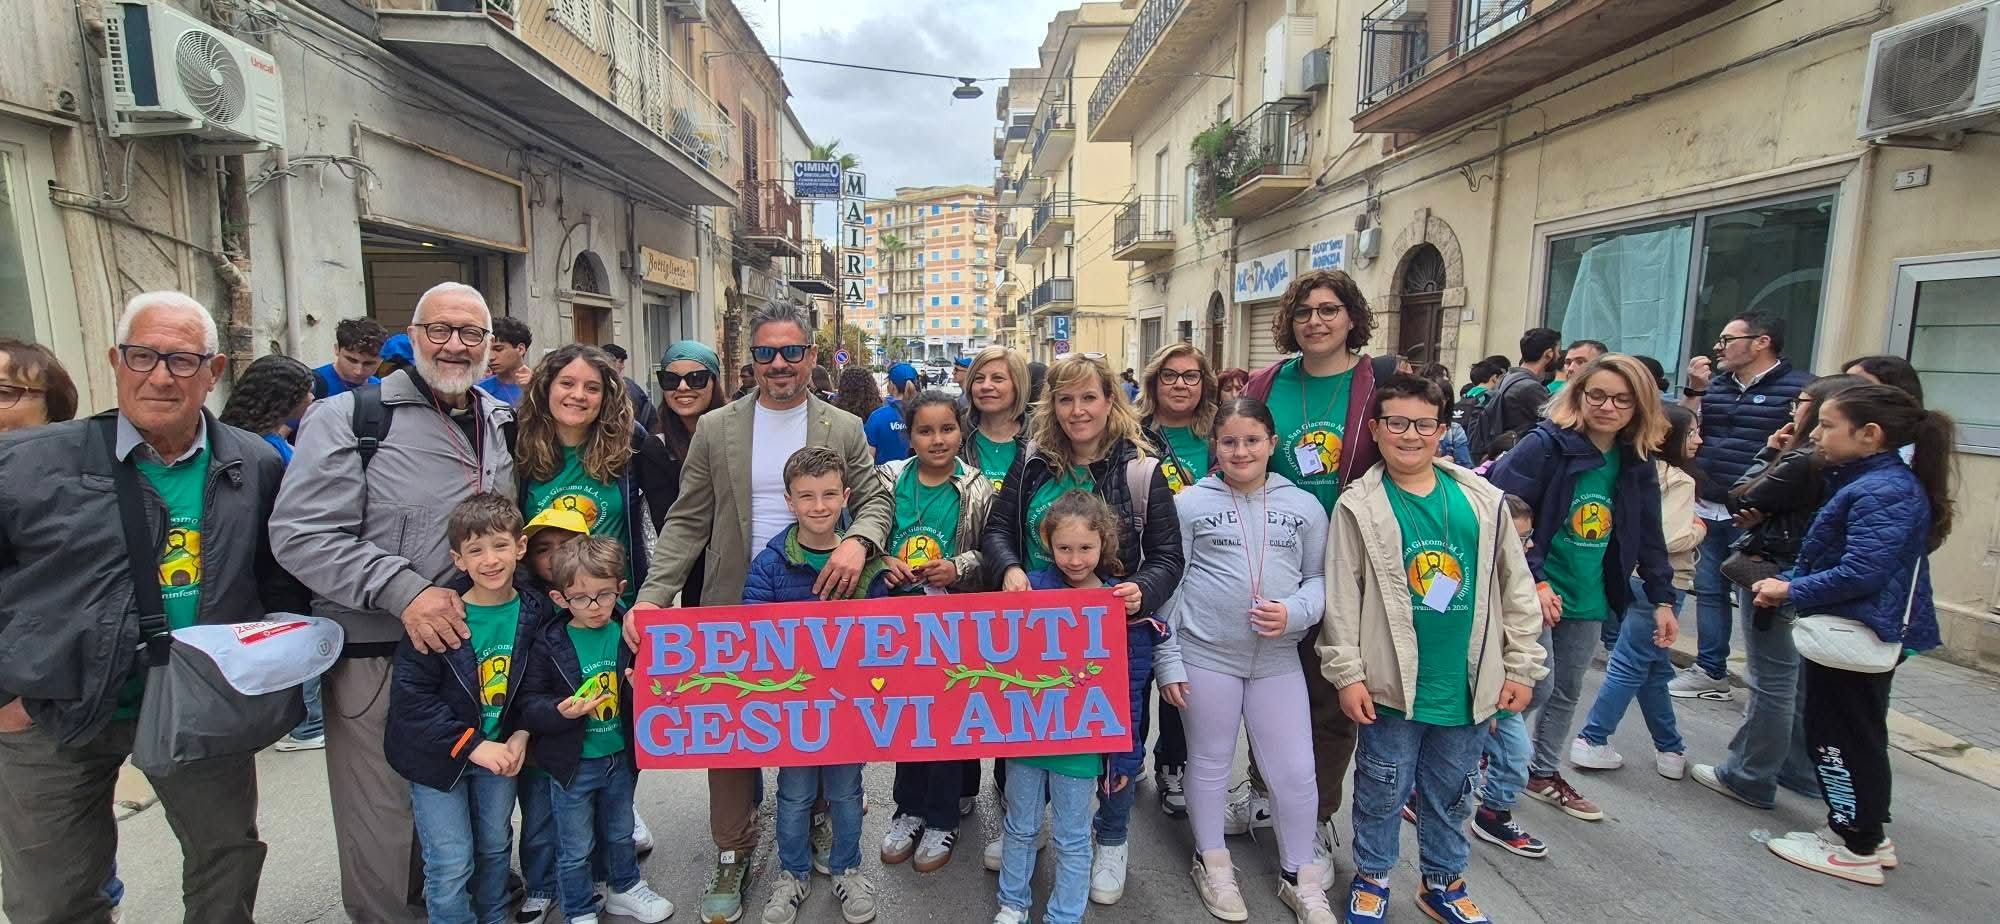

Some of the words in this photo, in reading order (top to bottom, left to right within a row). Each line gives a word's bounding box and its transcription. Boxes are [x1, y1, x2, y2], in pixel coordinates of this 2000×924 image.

[795, 162, 840, 178] CIMINO
[1907, 171, 1915, 184] 5
[845, 174, 864, 301] MAIRA
[1058, 317, 1066, 329] P
[1287, 428, 1302, 441] San
[1301, 420, 1337, 431] Giacomo
[537, 495, 551, 507] San
[550, 485, 583, 496] Giacomo
[908, 526, 937, 534] Giacomo
[1212, 538, 1241, 546] VINTAGE
[1411, 539, 1448, 550] Giacomo
[645, 605, 1111, 677] BENVENUTI
[582, 660, 616, 674] Giacomo
[853, 695, 937, 749] VI
[950, 686, 1126, 747] AMA
